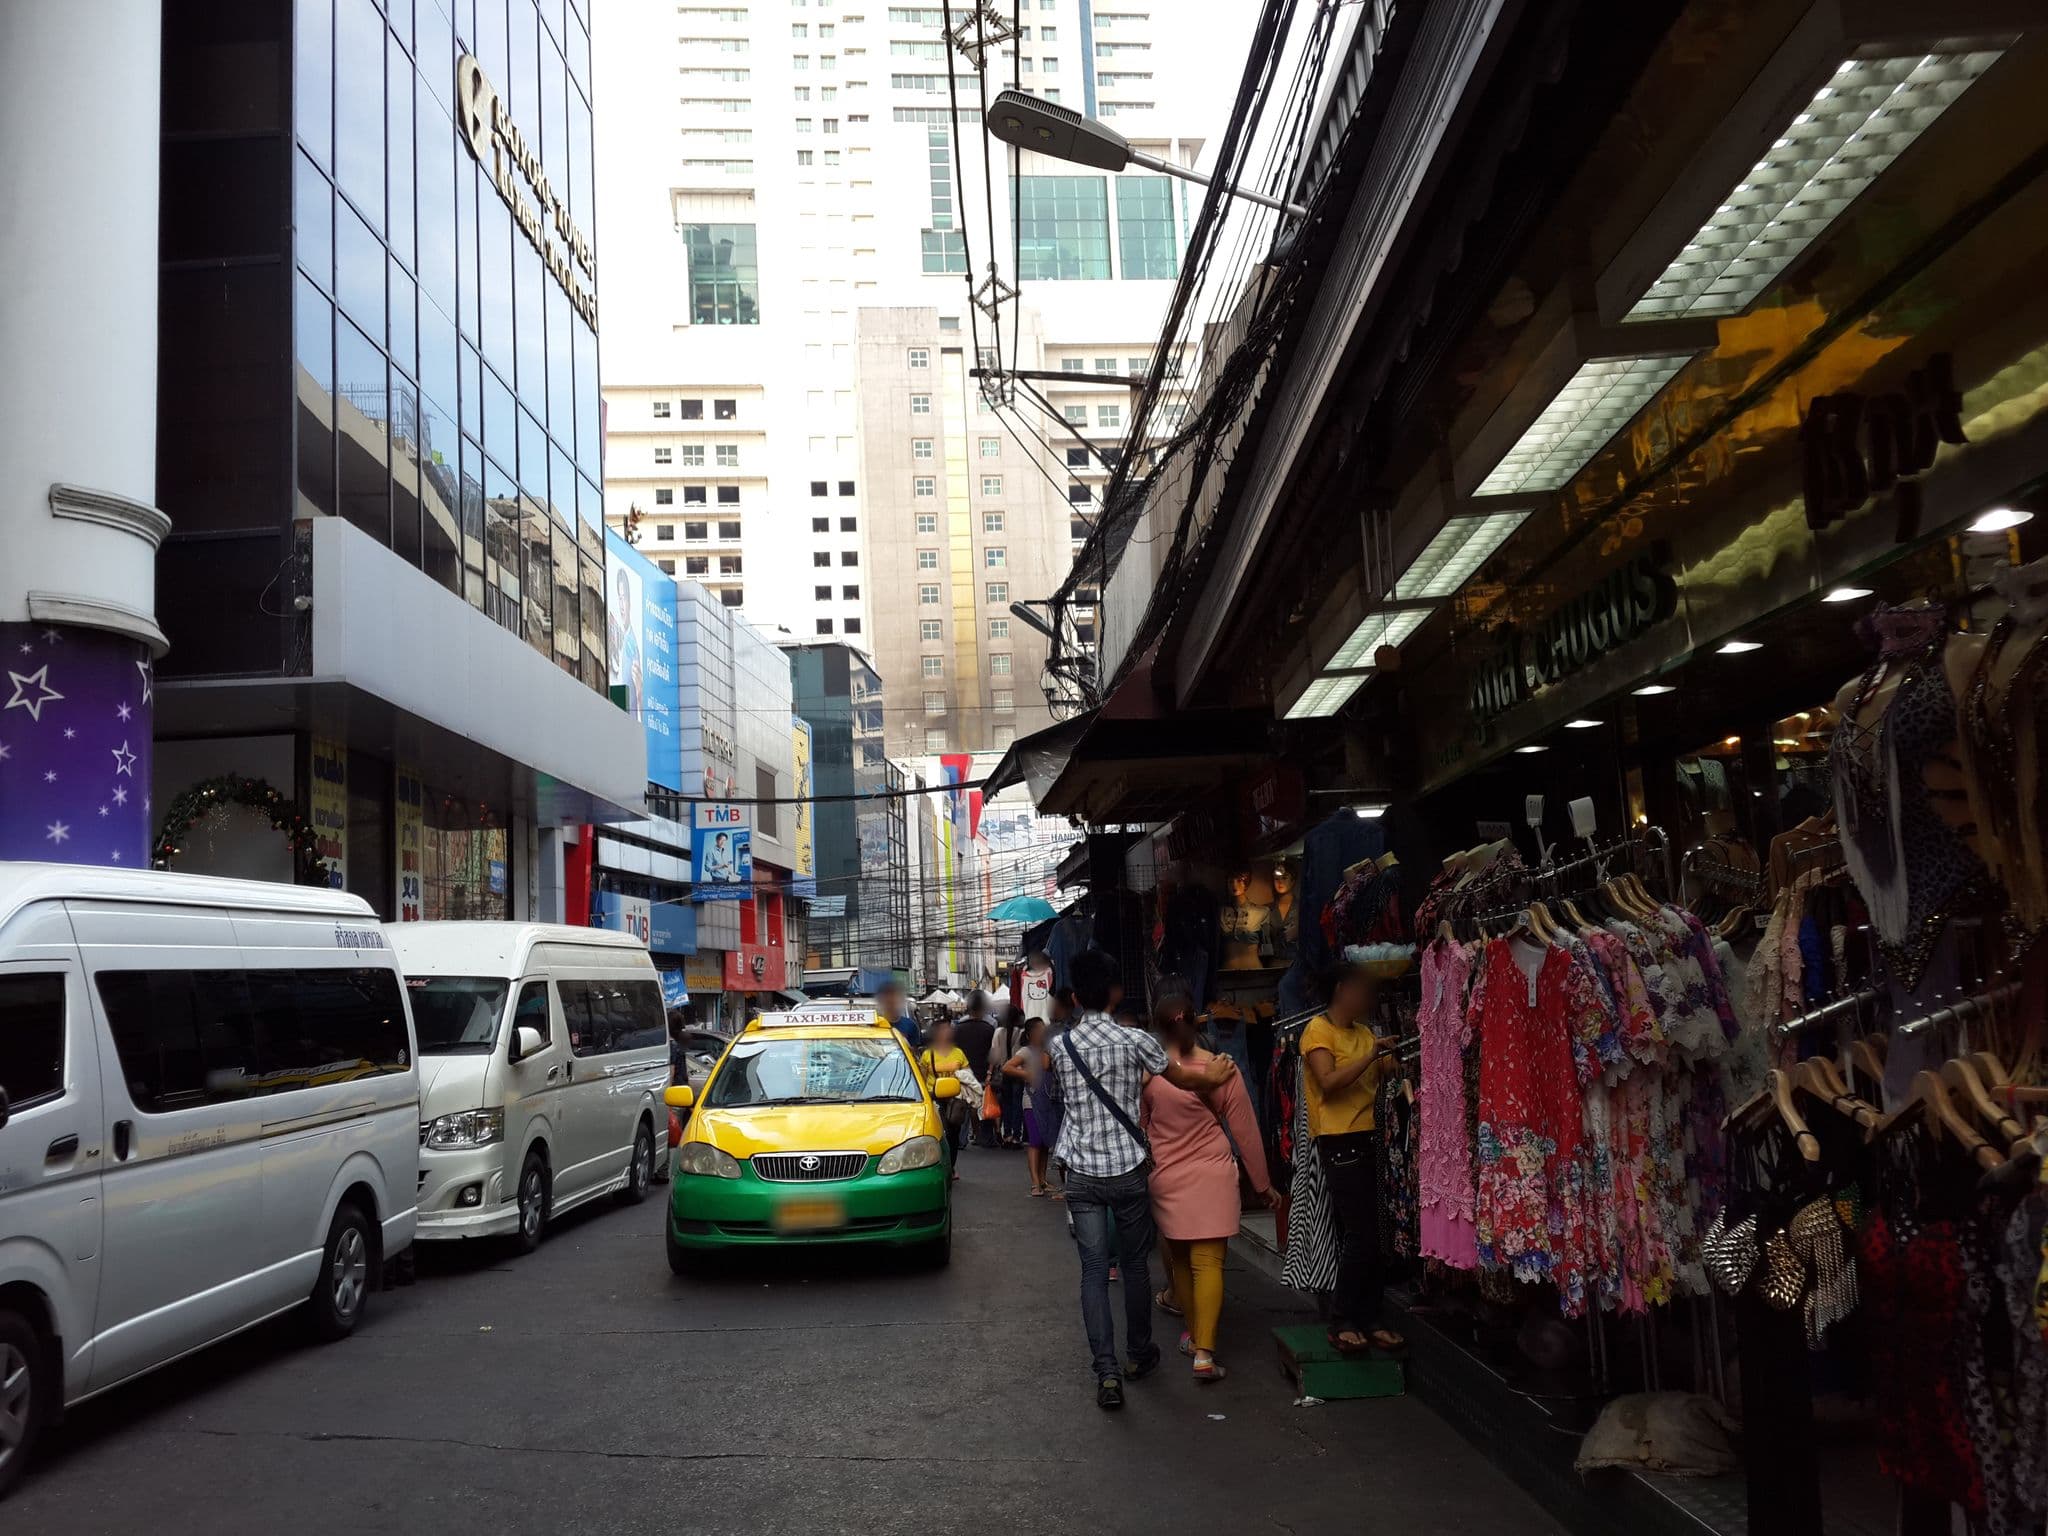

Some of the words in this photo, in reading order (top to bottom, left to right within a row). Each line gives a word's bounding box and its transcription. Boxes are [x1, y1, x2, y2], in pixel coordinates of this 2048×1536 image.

[704, 805, 741, 823] TMB
[625, 906, 649, 943] TMB
[784, 1013, 866, 1024] TAXI-METER
